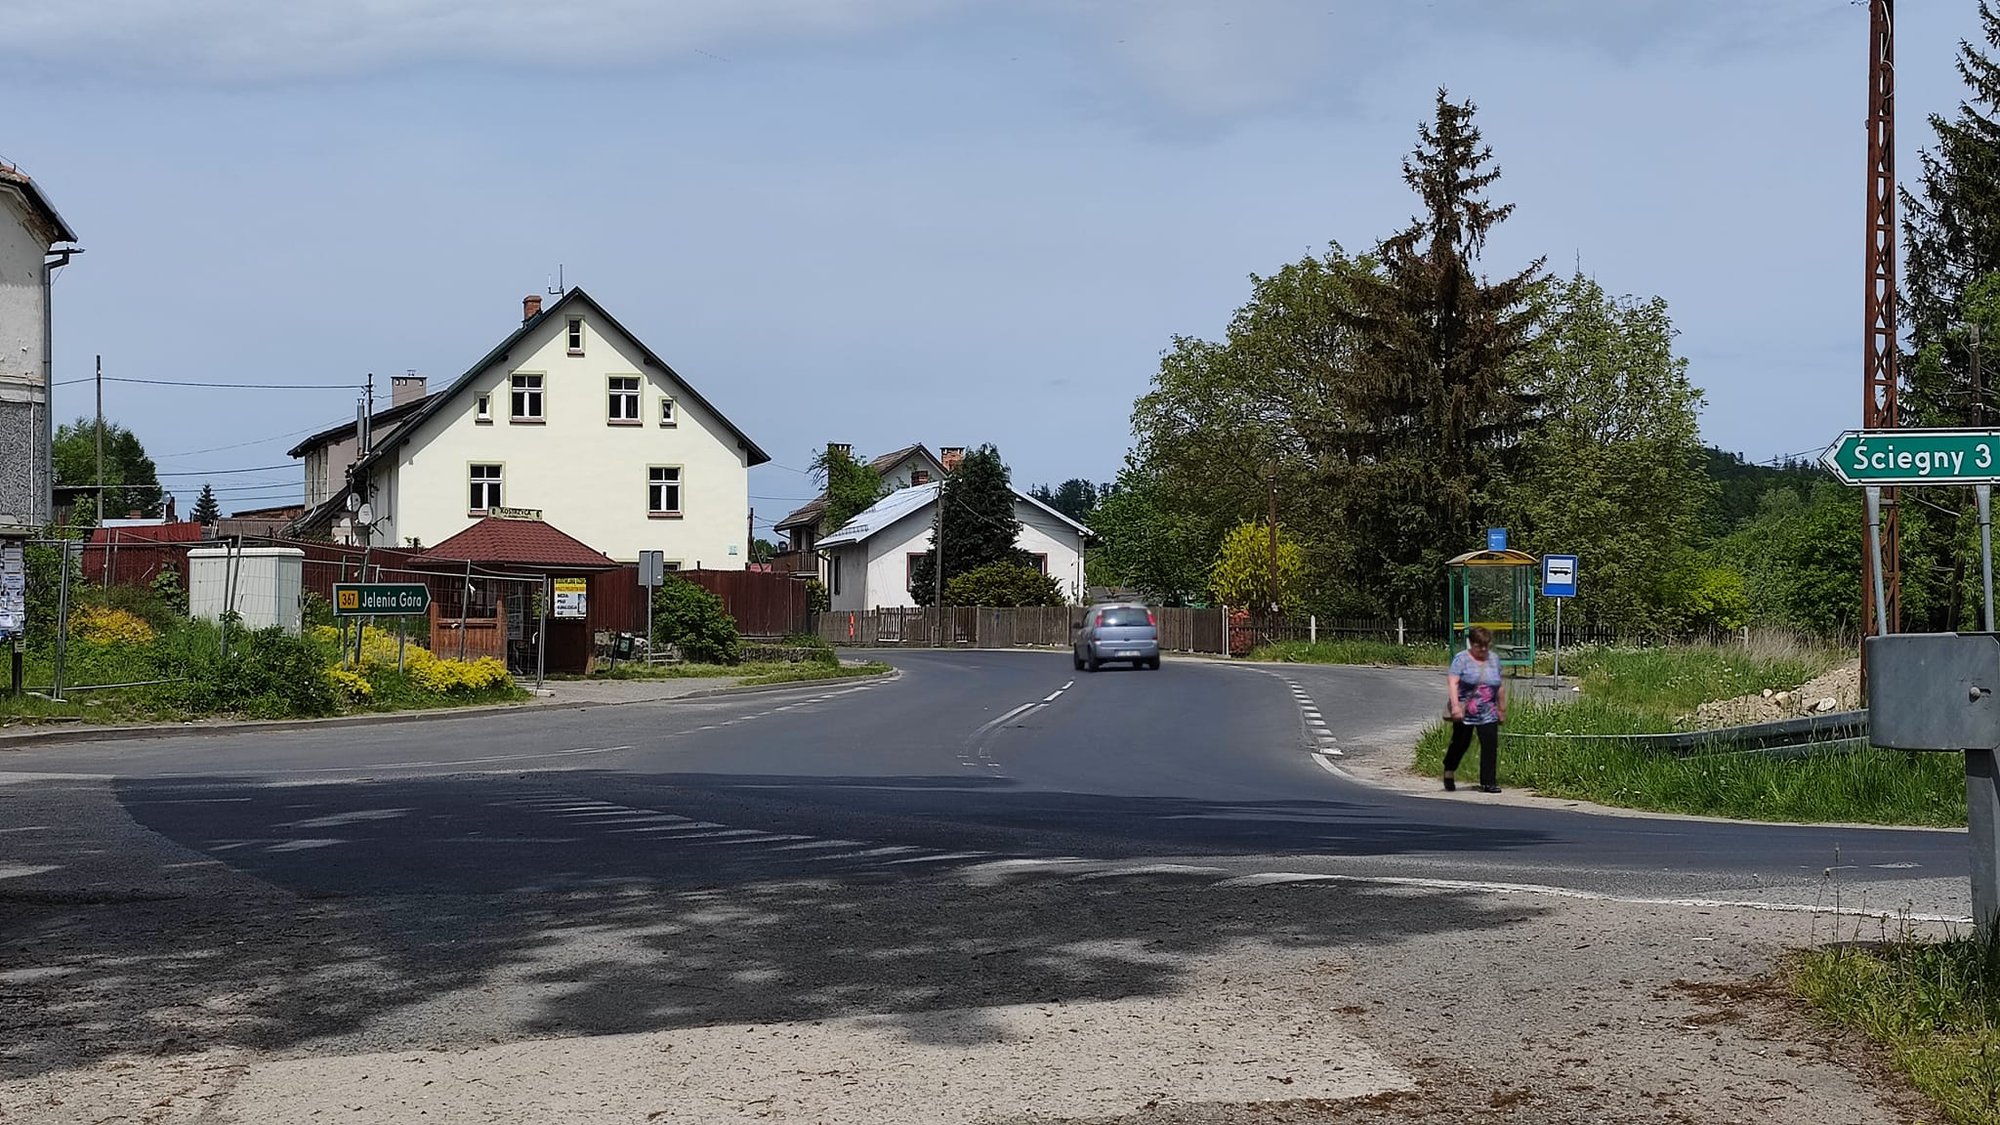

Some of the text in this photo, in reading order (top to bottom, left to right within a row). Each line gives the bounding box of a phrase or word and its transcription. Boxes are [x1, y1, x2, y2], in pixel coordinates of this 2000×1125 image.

[1853, 438, 1992, 475] Ściegny 3
[342, 591, 422, 608] 367 Jelenia Góra
